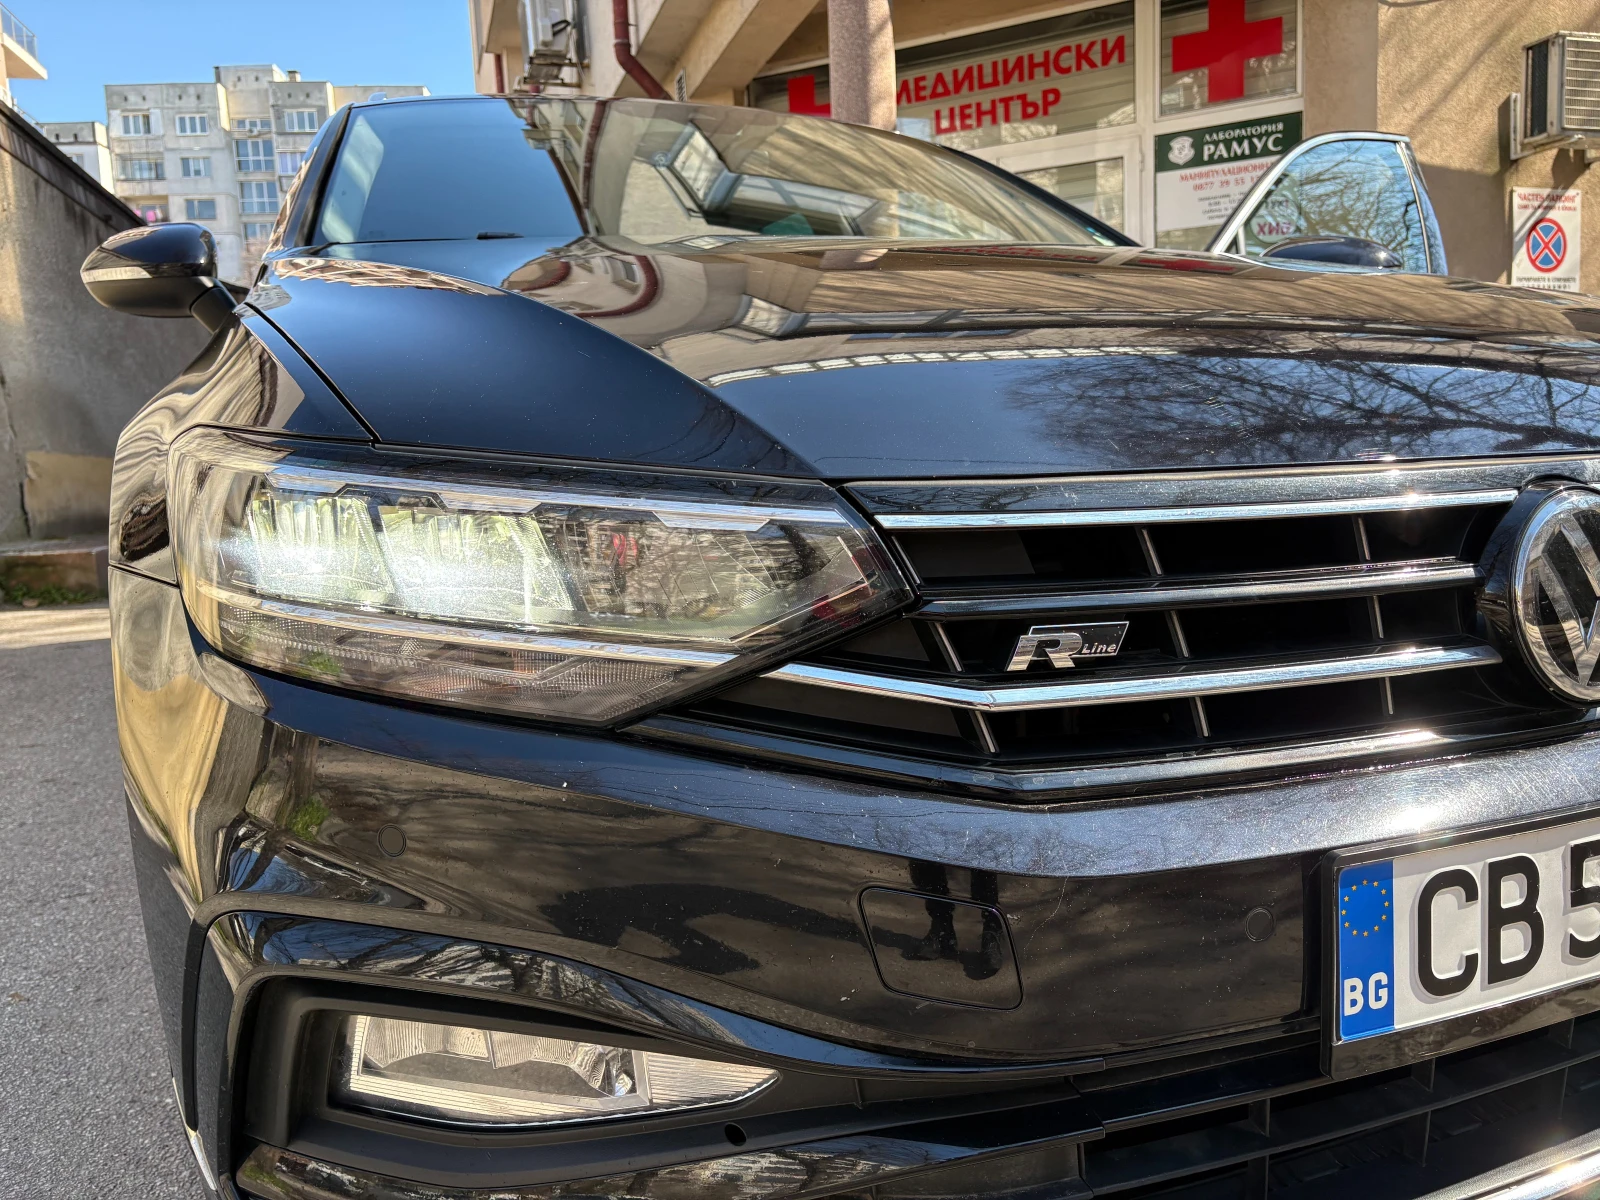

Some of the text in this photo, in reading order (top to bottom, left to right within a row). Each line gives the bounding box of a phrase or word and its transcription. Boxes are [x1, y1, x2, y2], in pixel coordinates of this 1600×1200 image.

[934, 87, 1062, 135] ЦЕНТЪР
[1202, 133, 1283, 161] РАМУС
[1203, 122, 1284, 143] ЛАБОРАТОРИЯ
[1006, 632, 1117, 672] R Line
[1417, 855, 1545, 997] CB
[1343, 972, 1389, 1016] BG
